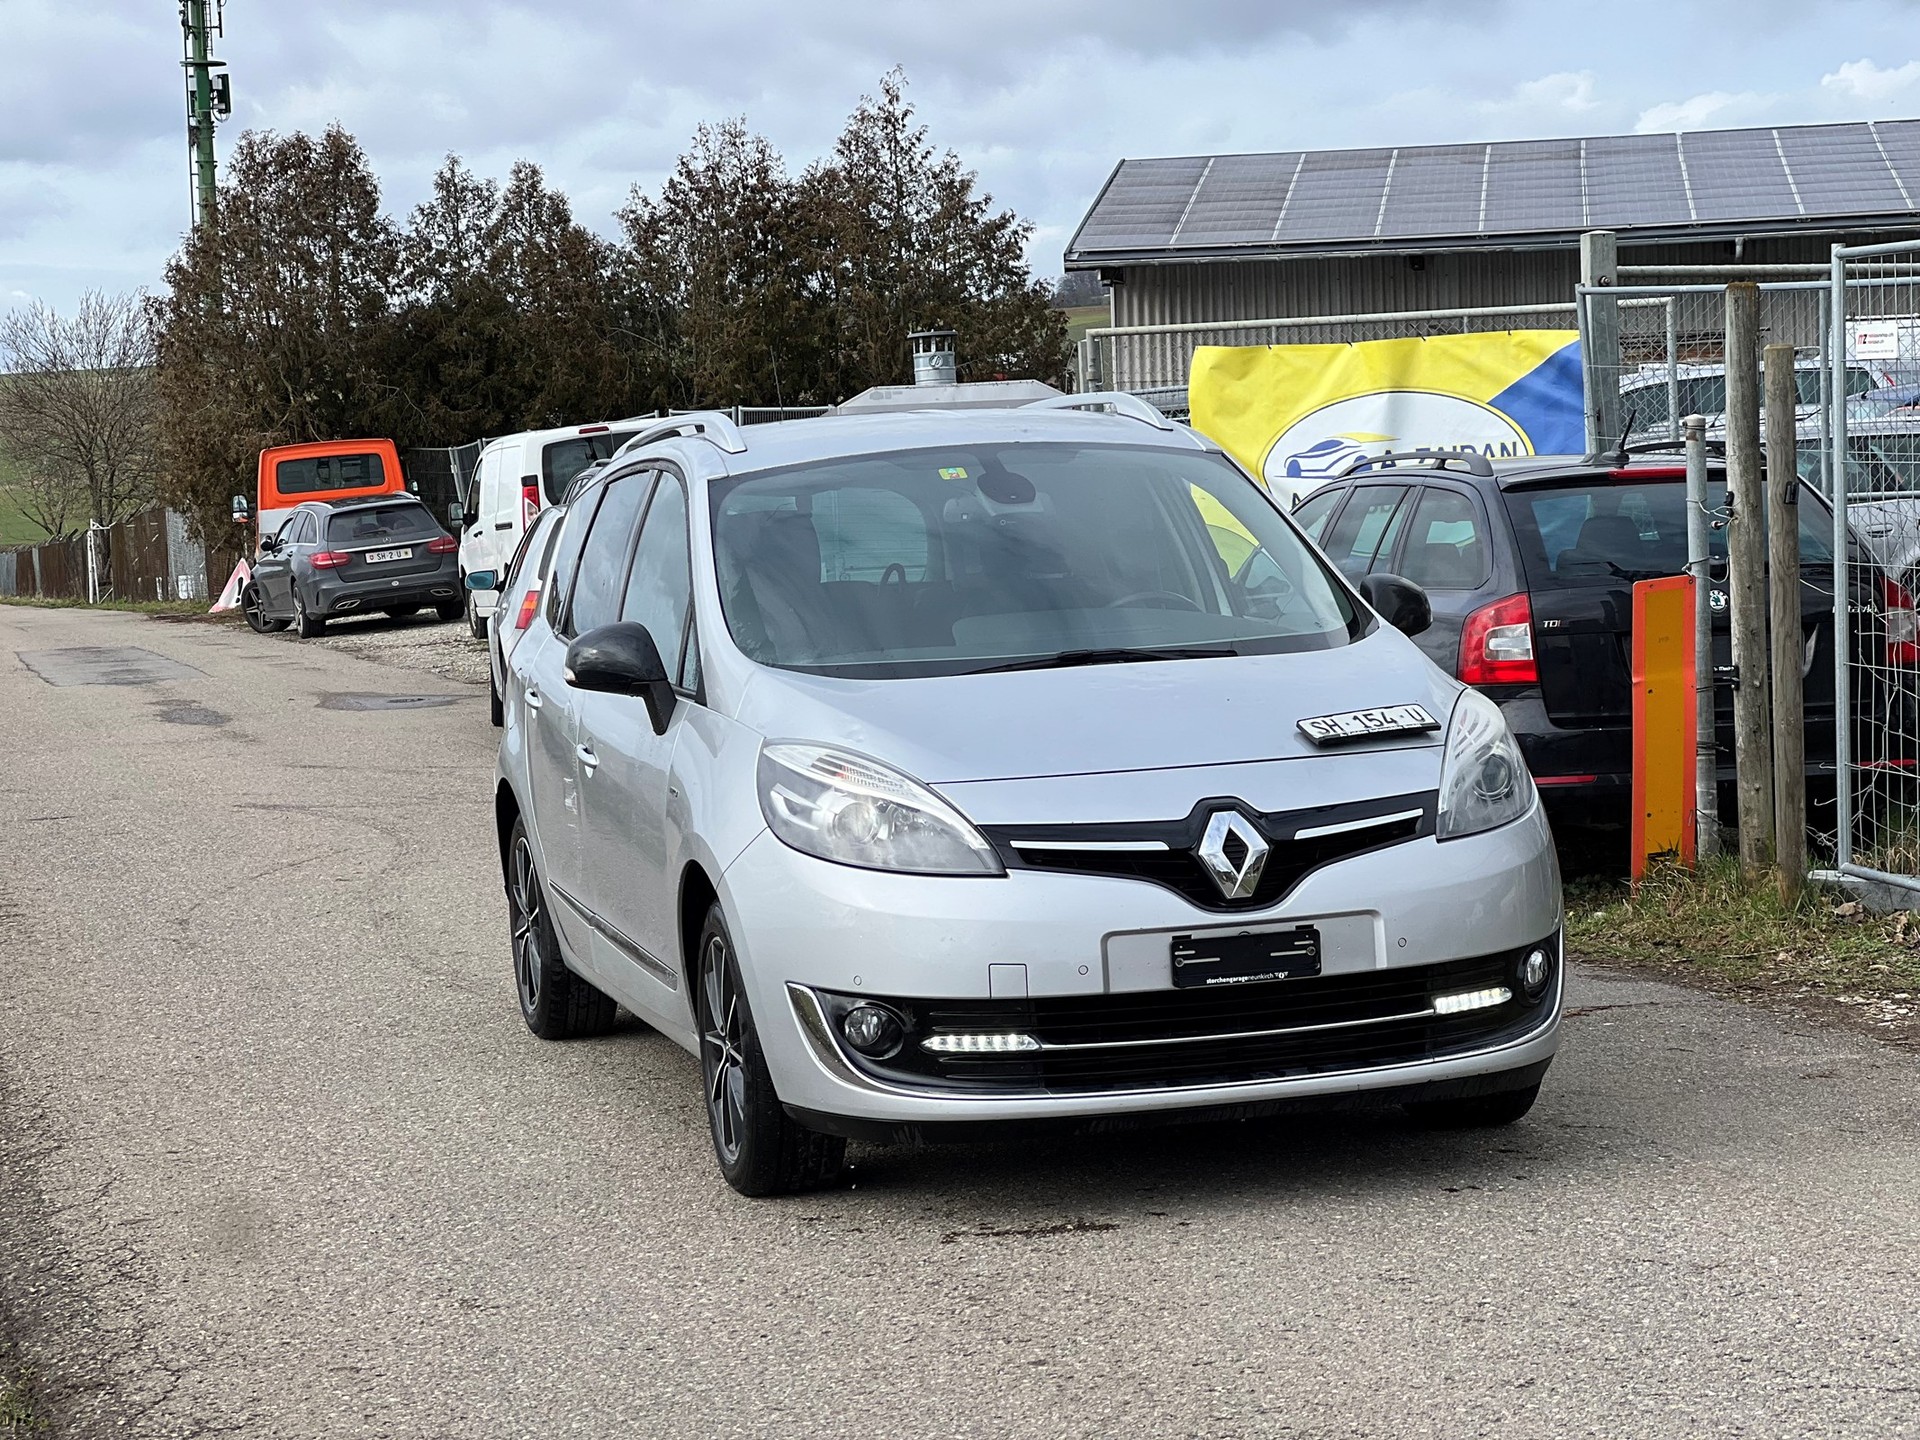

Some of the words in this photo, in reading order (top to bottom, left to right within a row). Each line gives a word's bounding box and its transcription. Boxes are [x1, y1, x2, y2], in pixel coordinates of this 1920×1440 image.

[376, 552, 386, 561] SH
[388, 551, 394, 559] 2
[396, 550, 402, 558] U
[1542, 619, 1561, 628] TDI
[1310, 718, 1344, 736] SH
[1352, 711, 1398, 729] 154
[1404, 707, 1426, 723] U
